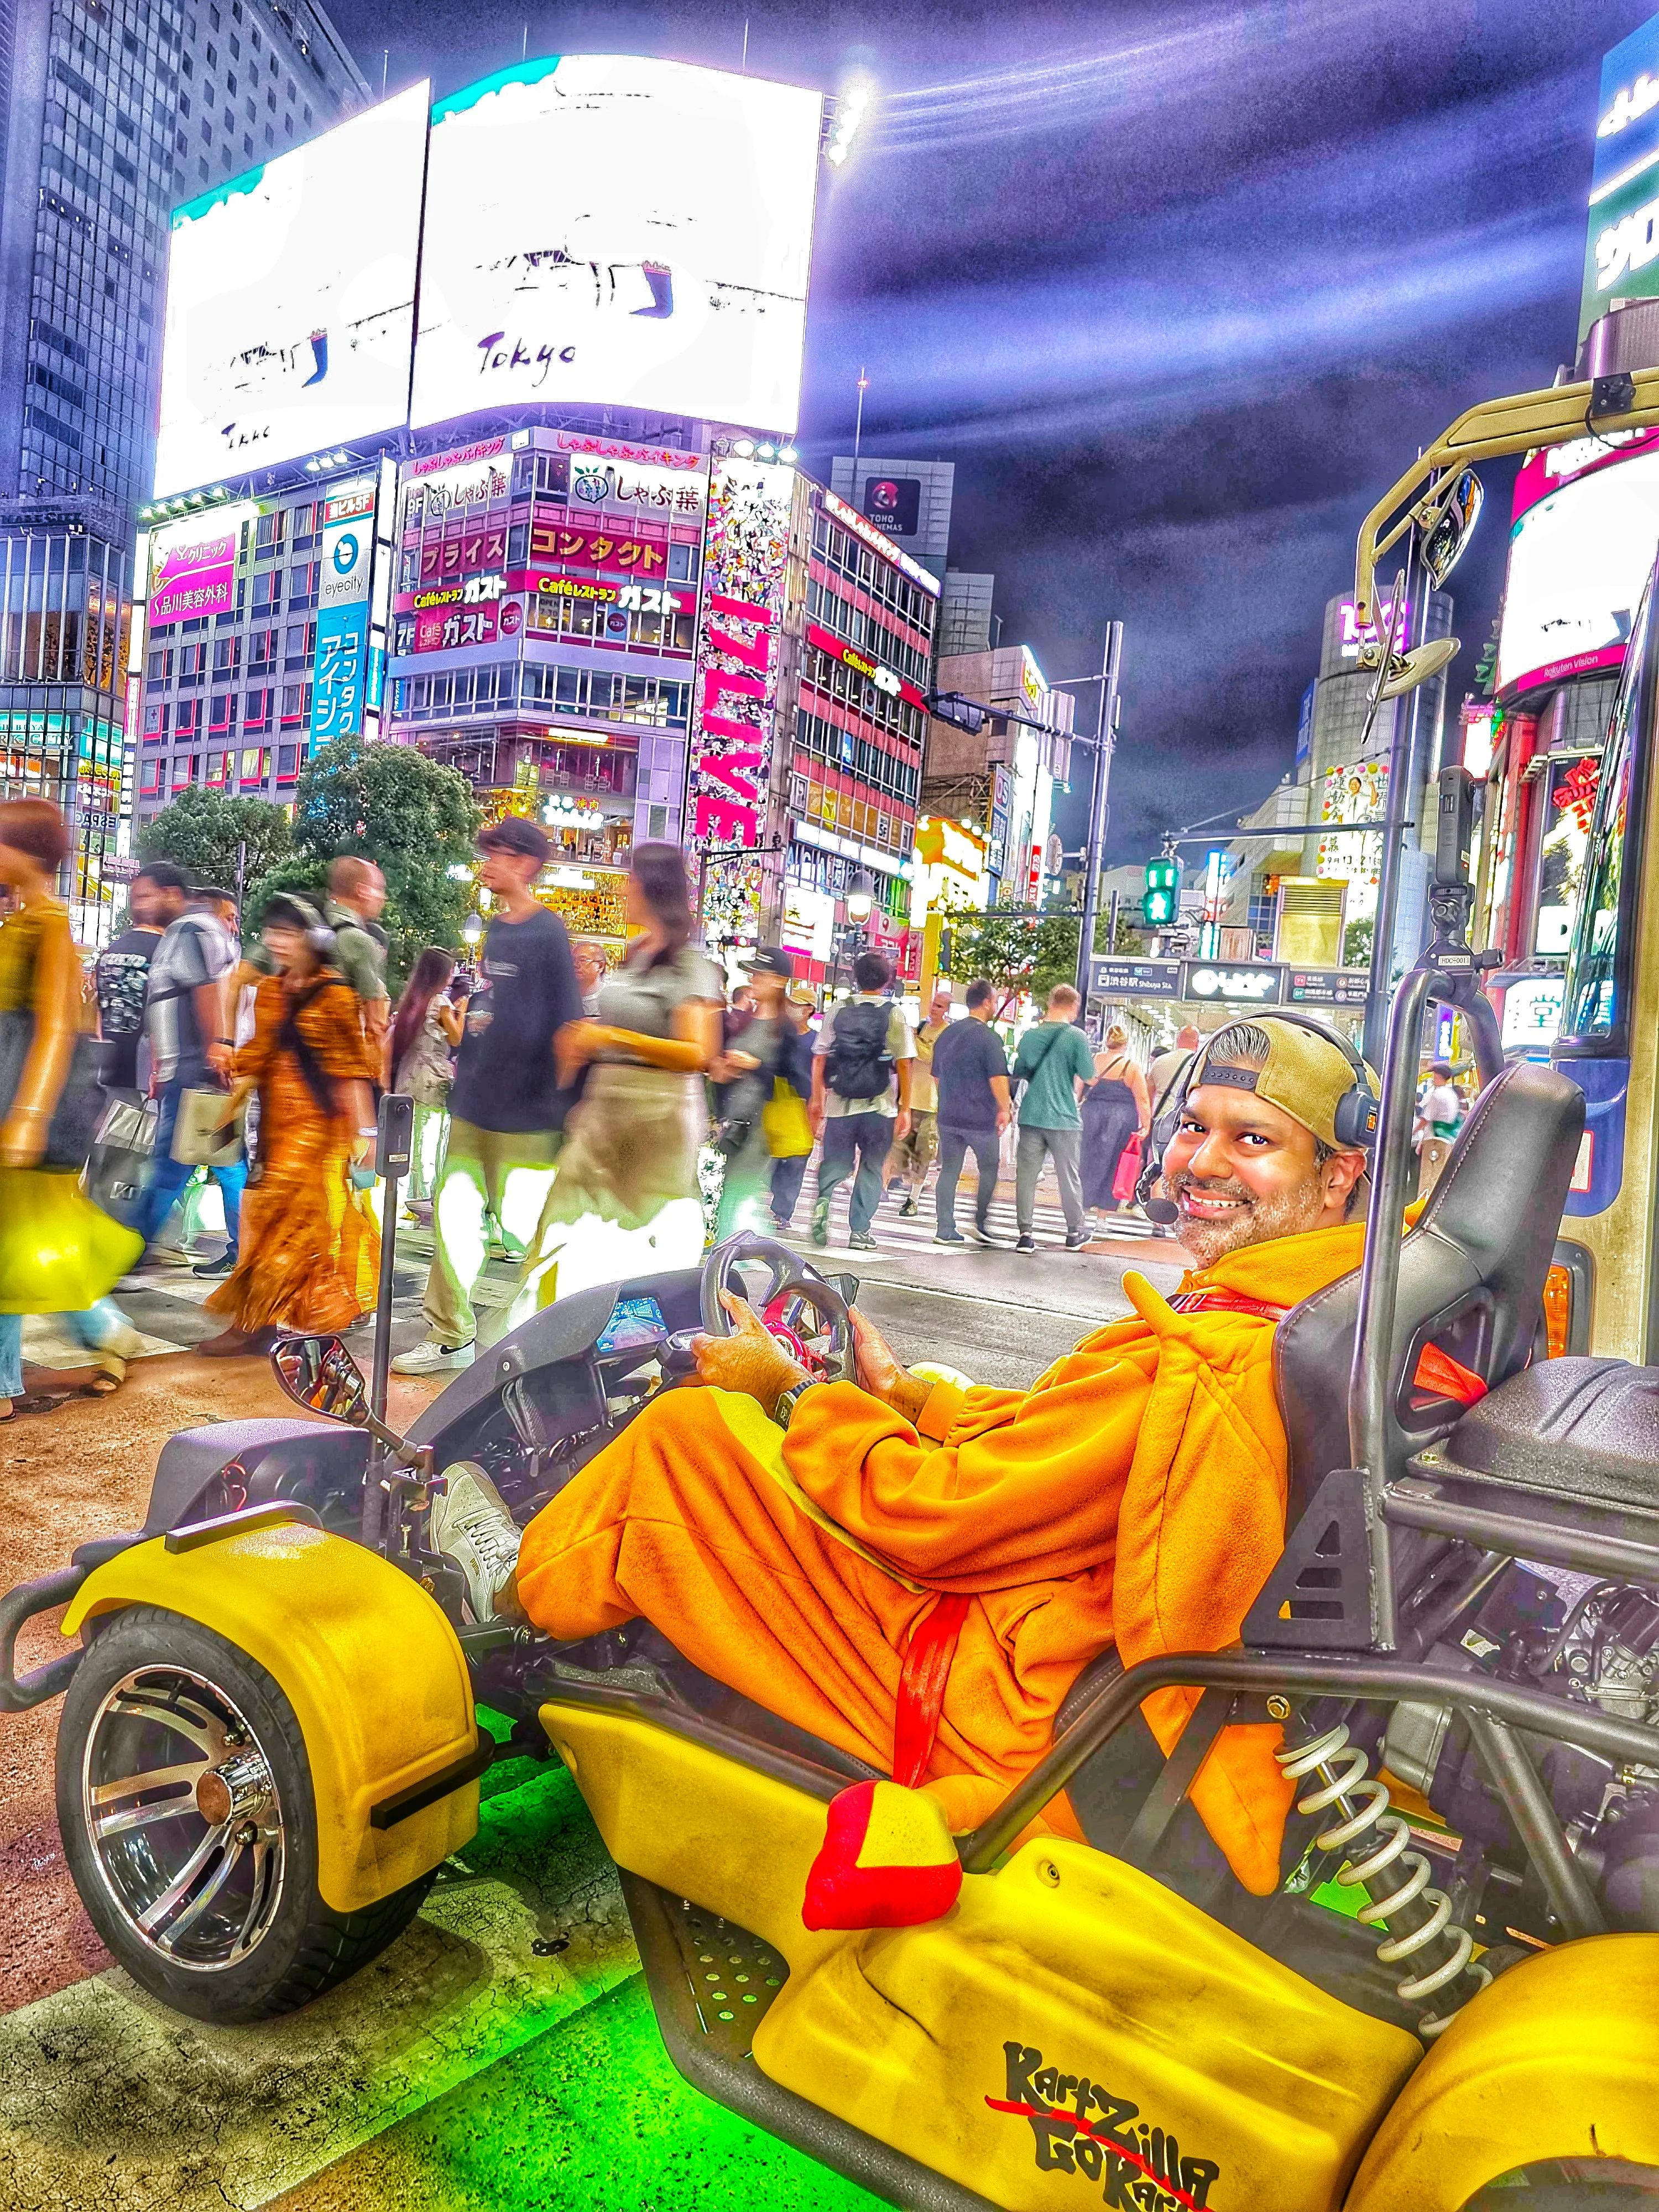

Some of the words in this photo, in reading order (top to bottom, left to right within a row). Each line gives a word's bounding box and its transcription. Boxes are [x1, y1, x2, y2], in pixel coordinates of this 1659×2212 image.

[477, 331, 576, 387] Tokyo
[413, 436, 505, 474] しゃぶしゃぶバイキング
[557, 432, 701, 469] しゃぶしゃぶバイキング
[408, 497, 422, 513] 9F
[455, 472, 506, 505] しゃぶ葉
[617, 476, 699, 510] しゃぶ葉
[870, 514, 894, 523] TOHO
[424, 533, 503, 573] プライス
[532, 528, 663, 570] コンタクト
[160, 581, 228, 616] 品川美容外科
[325, 576, 363, 598] eyecity
[463, 575, 507, 604] ガスト
[618, 586, 681, 614] ガスト
[398, 628, 414, 647] 7F
[420, 623, 441, 638] Café
[442, 612, 493, 647] ガスト
[1544, 662, 1573, 678] Rakuten
[1574, 655, 1599, 669] Vision
[1139, 980, 1161, 990] Shibuya
[1003, 2041, 1220, 2210] KartZilla
